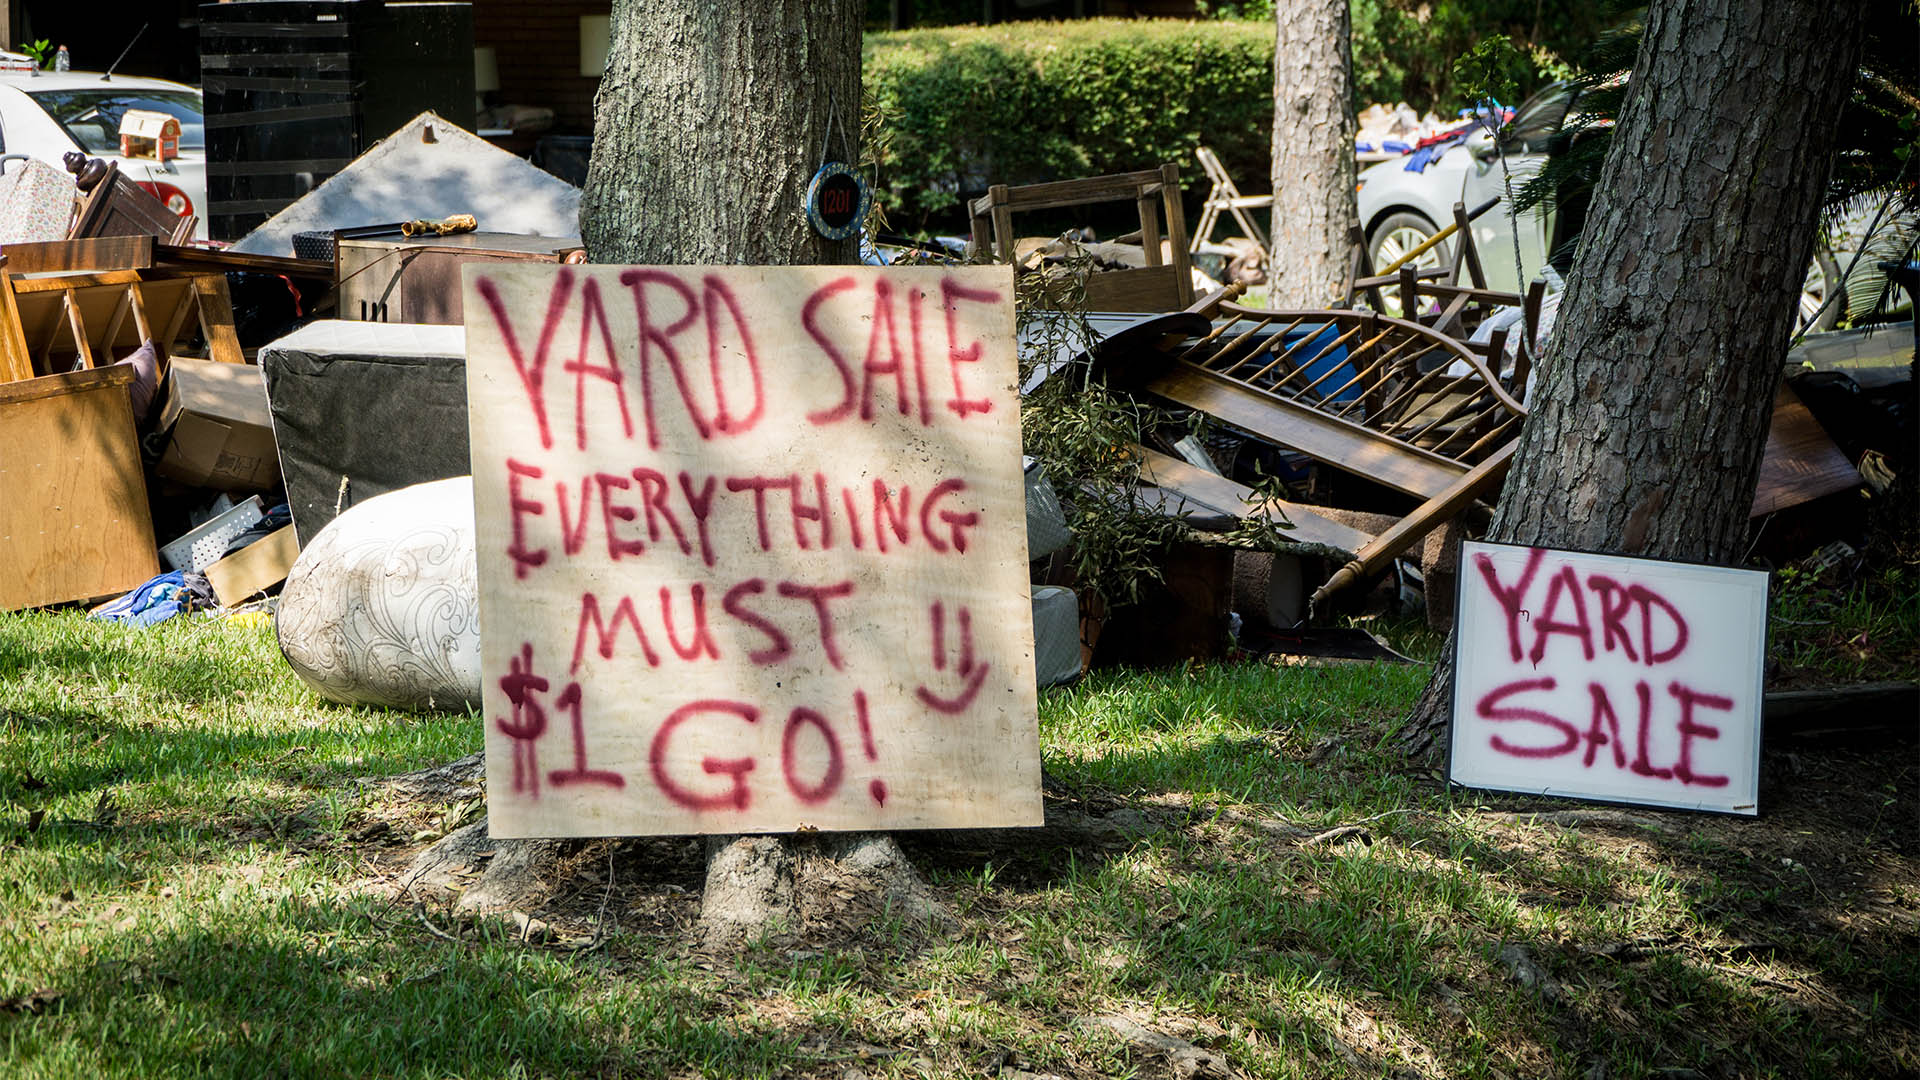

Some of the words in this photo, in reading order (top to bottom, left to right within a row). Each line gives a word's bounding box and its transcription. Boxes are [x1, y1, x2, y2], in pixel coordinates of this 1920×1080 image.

[823, 189, 850, 215] 1201
[476, 267, 764, 451] YARD
[506, 458, 979, 578] EVERYTHING
[570, 579, 856, 674] MUST
[1474, 548, 1690, 669] YARD
[497, 642, 627, 798] $1
[649, 689, 888, 808] GO!
[1476, 676, 1734, 788] SALE
